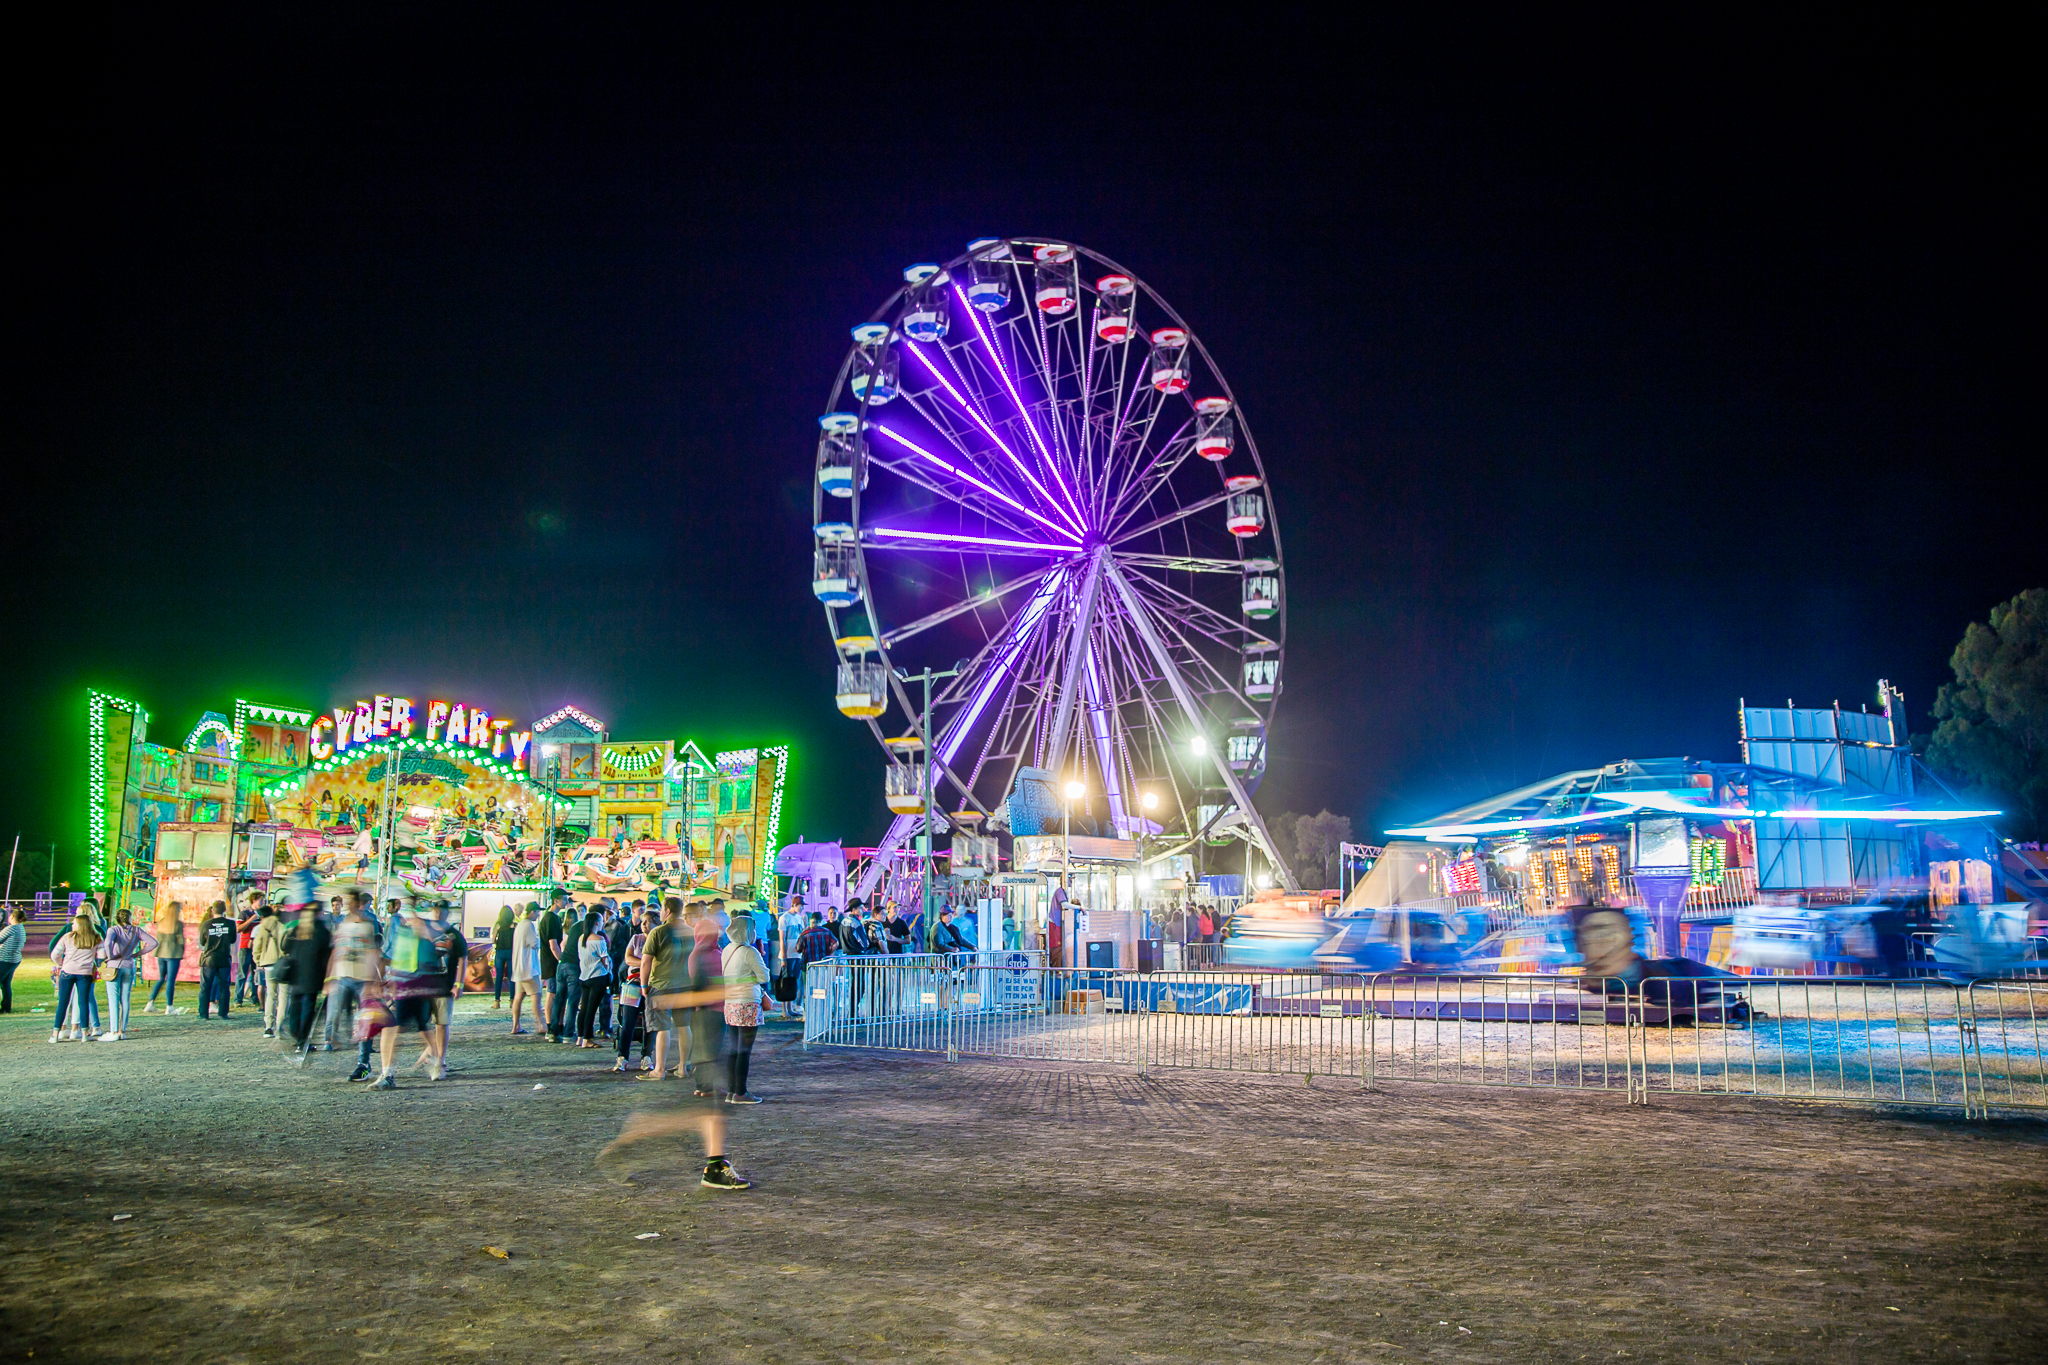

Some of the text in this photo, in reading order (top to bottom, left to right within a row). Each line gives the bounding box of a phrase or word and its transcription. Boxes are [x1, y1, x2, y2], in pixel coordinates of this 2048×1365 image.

[311, 694, 531, 770] CYBER PARTY
[1029, 840, 1056, 852] SUPER
[1002, 876, 1037, 884] Entrance
